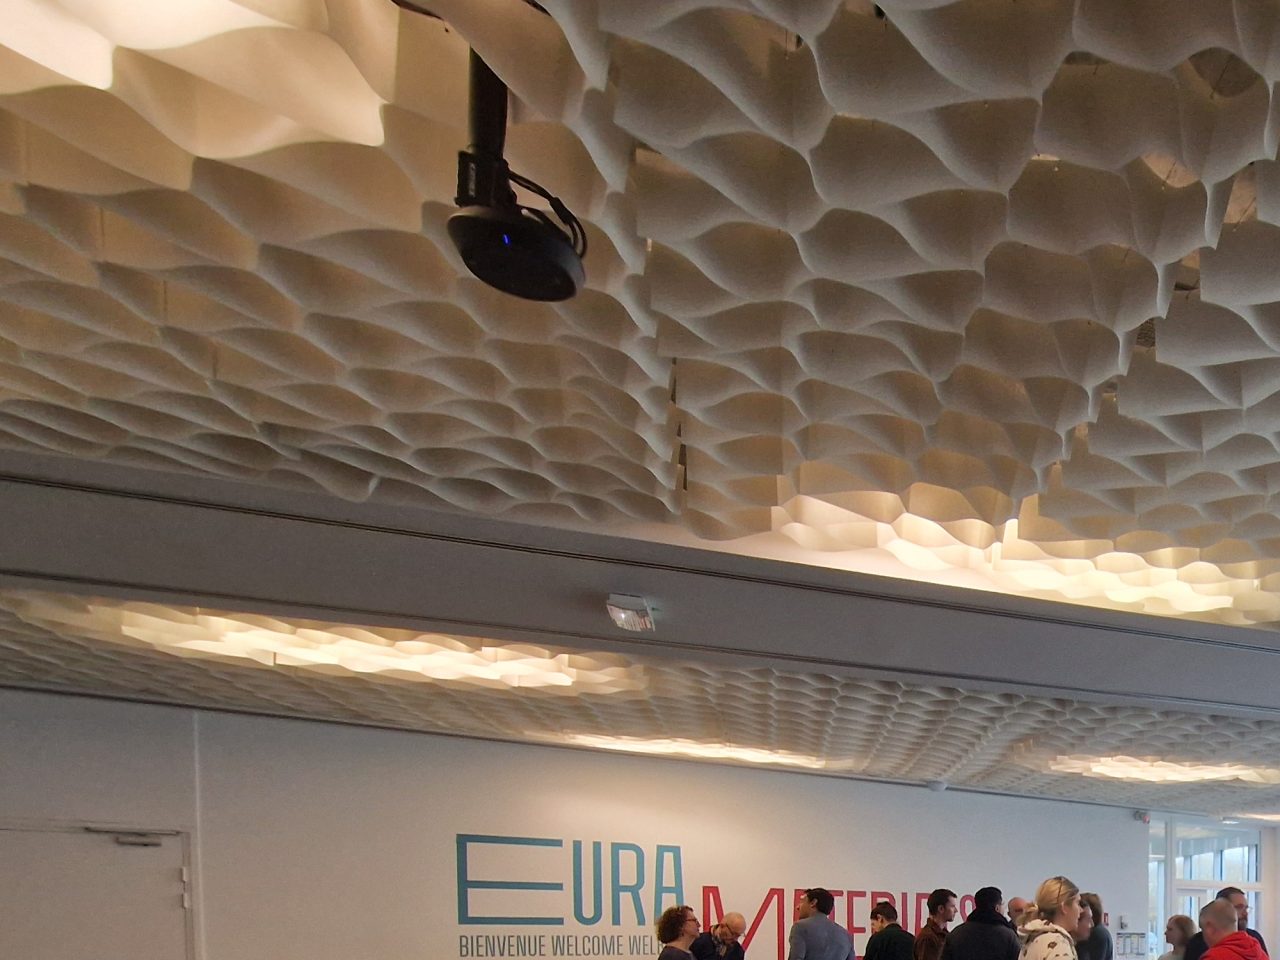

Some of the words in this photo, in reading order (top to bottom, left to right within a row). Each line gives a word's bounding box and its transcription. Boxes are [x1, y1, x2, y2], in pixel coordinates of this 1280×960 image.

[456, 833, 684, 926] EURA
[459, 935, 546, 957] BIENVENUE
[551, 935, 623, 956] WELCOME
